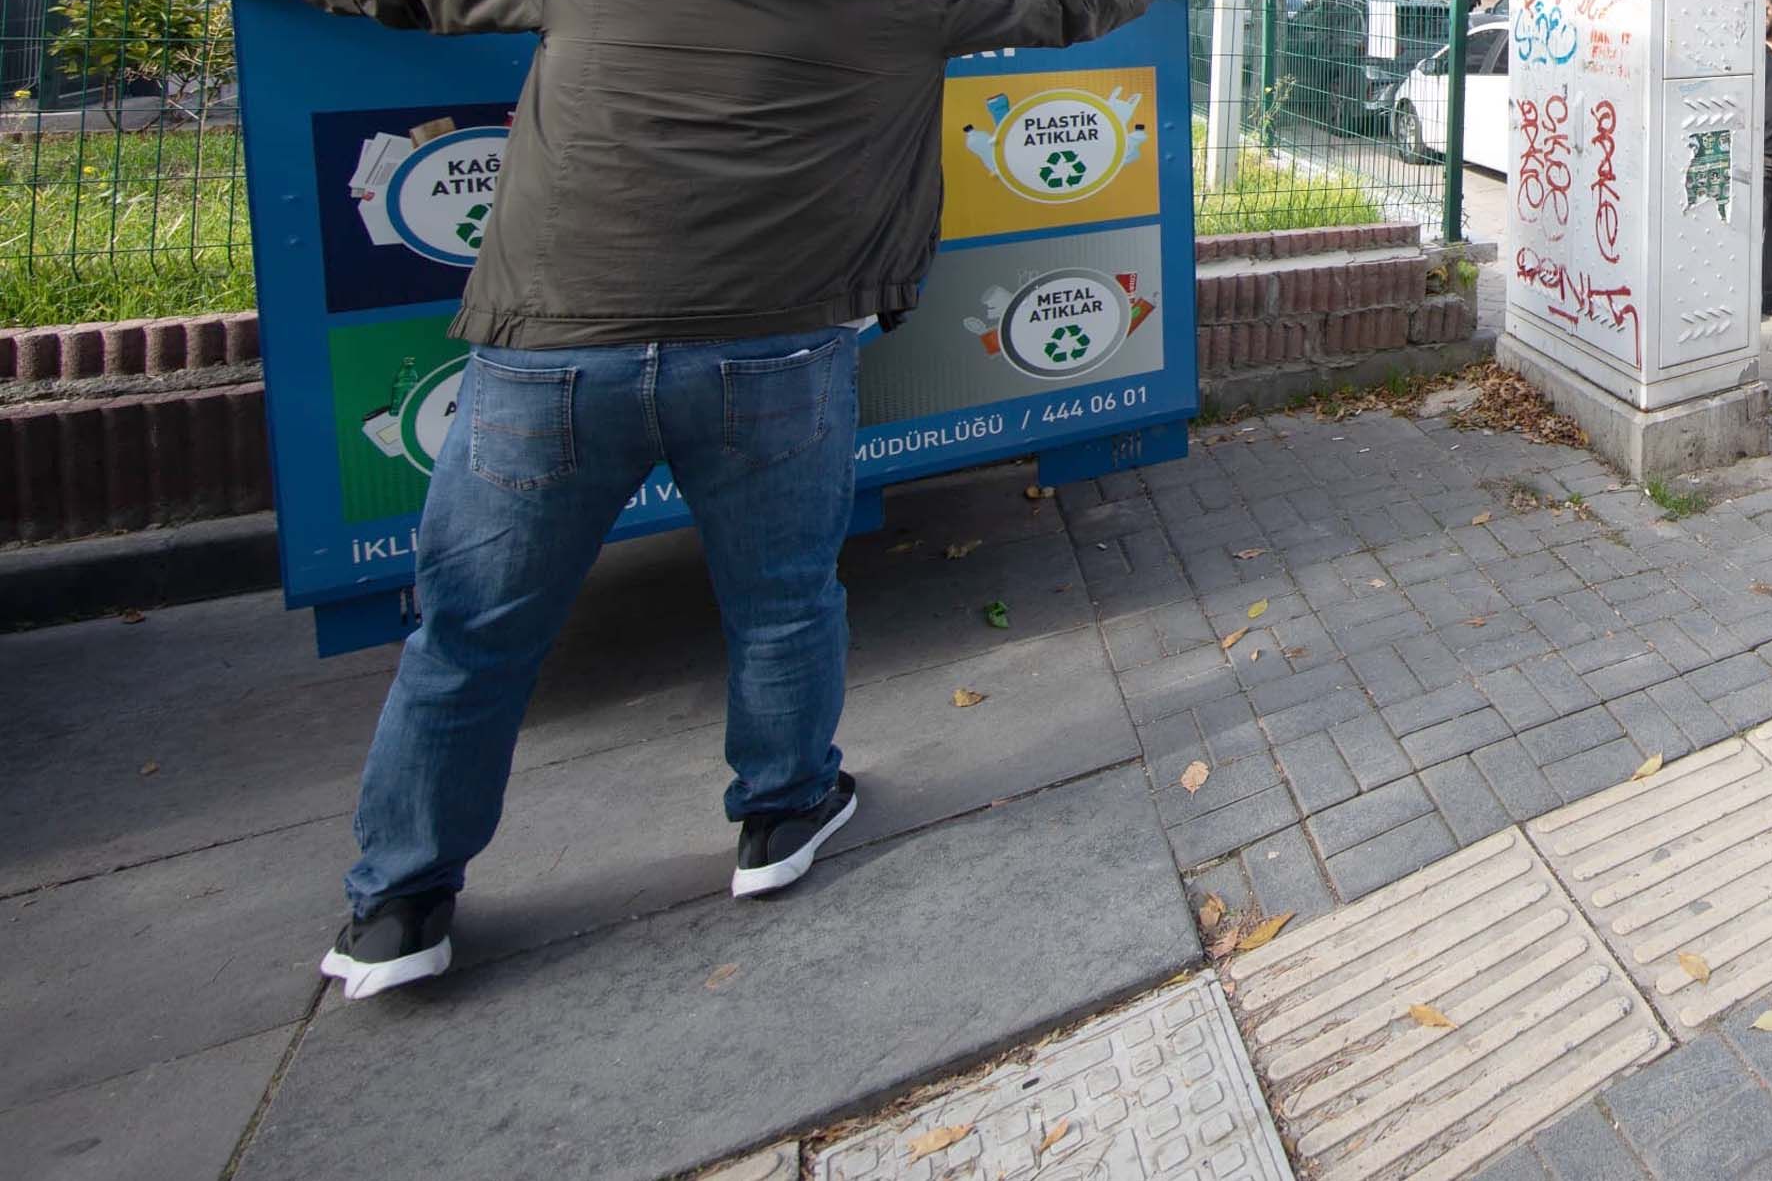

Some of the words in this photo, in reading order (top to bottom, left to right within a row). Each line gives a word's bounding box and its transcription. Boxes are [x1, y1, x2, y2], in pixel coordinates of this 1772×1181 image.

[1024, 111, 1098, 132] PLASTİK
[1023, 128, 1099, 147] ATIKLAR
[448, 153, 501, 176] KAĞ
[431, 176, 498, 197] ATIK
[1037, 287, 1095, 308] METAL
[1029, 300, 1103, 324] ATIKLAR
[352, 528, 417, 564] İKLİ
[854, 414, 1003, 462] MÜDÜRLÜĞÜ
[1042, 400, 1084, 423] 444
[1091, 393, 1117, 413] 06
[1123, 386, 1148, 407] 01
